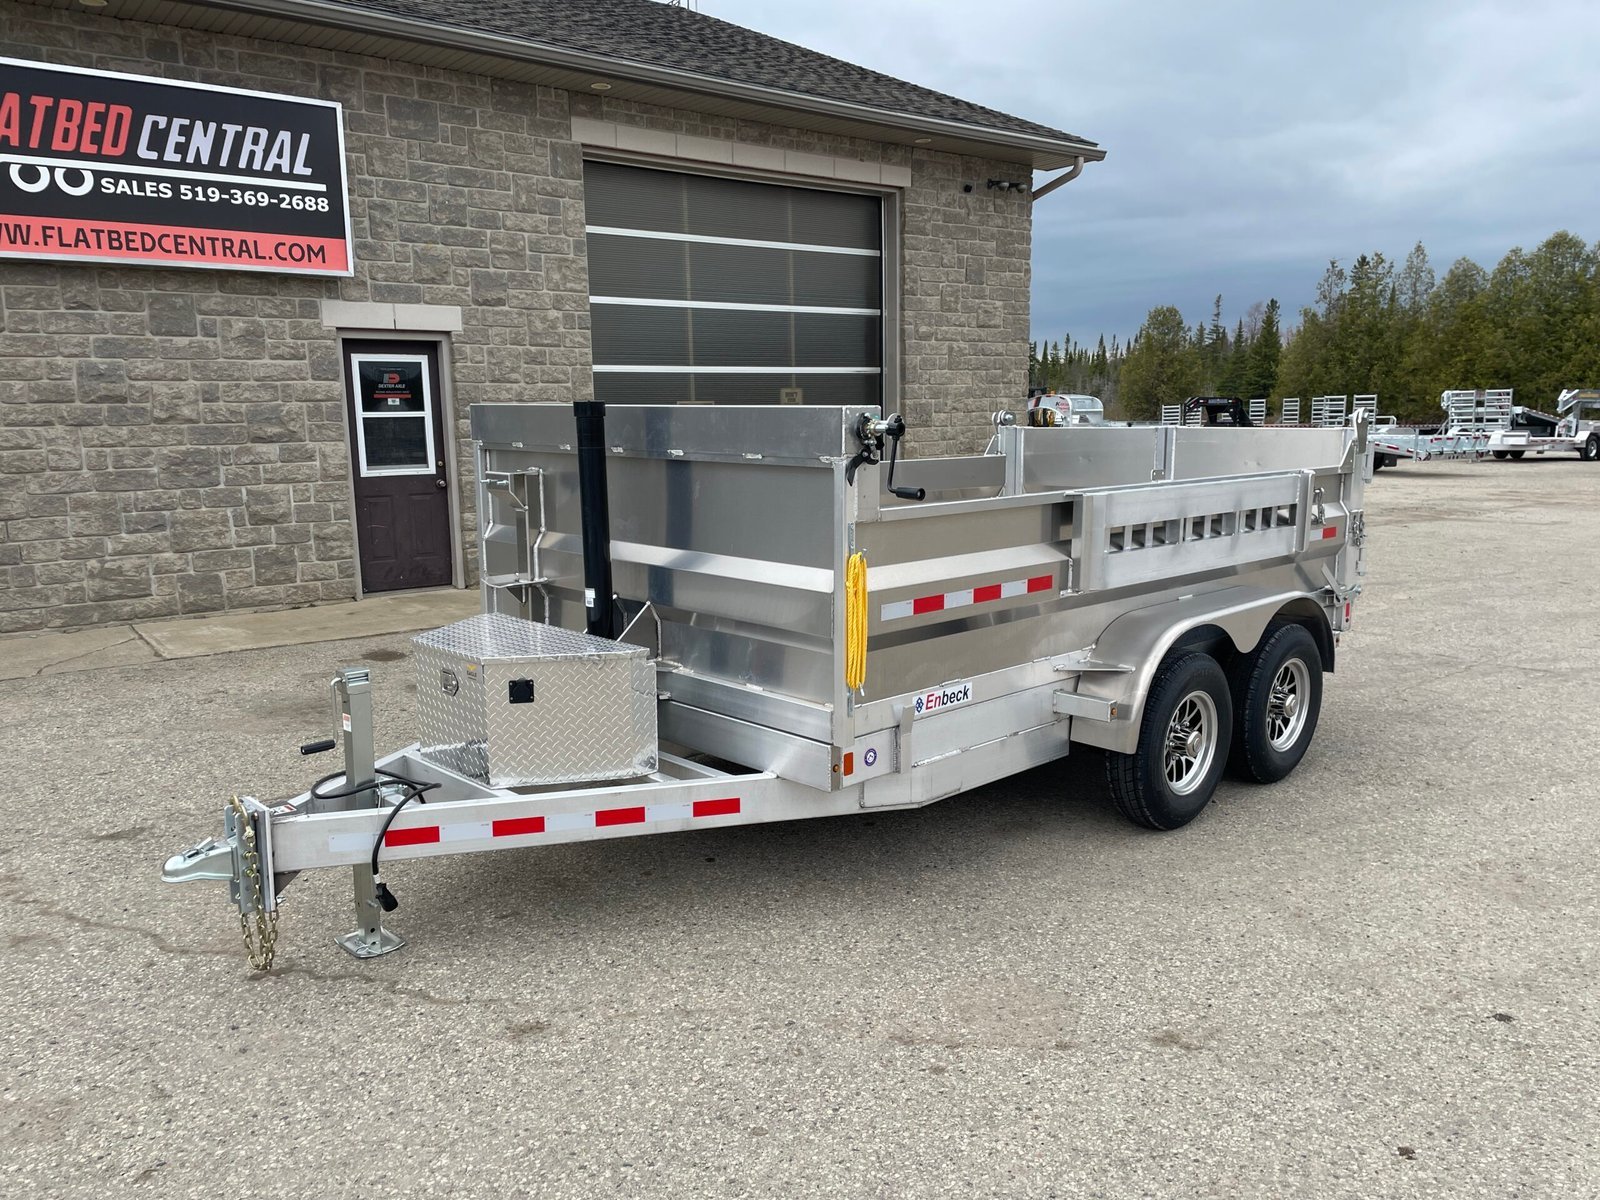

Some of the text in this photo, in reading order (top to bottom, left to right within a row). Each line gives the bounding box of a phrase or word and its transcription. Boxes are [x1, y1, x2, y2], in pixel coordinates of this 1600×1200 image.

[136, 114, 313, 176] CENTRAL
[101, 177, 330, 213] SALES 519-369-2688
[0, 222, 327, 264] W.FLATBEDCENTRAL.COM
[925, 685, 970, 711] Enbeck
